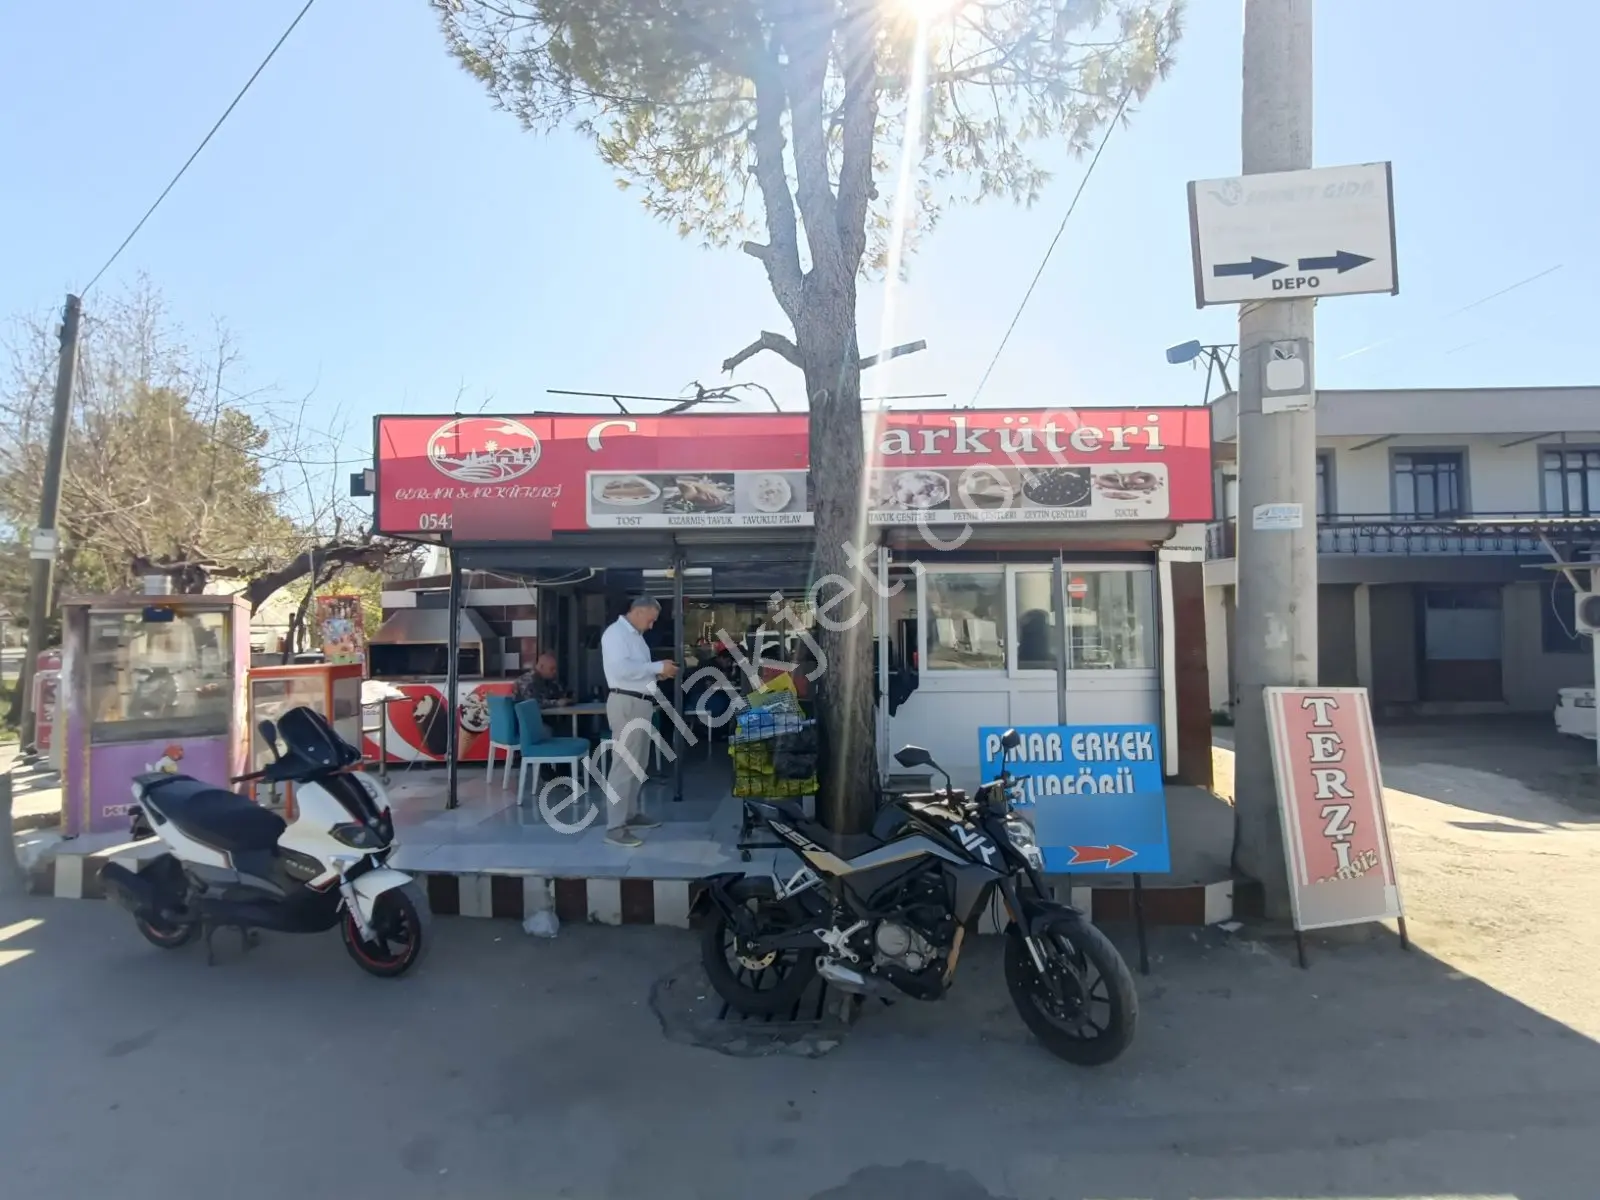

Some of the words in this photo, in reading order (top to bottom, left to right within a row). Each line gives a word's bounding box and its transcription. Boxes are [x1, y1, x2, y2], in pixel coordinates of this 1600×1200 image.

[1272, 275, 1320, 291] DEPO
[879, 412, 1166, 457] arküteri
[742, 514, 778, 525] TAVUKLU
[1114, 508, 1139, 518] SUCUK
[615, 516, 642, 525] TOST
[1071, 730, 1154, 762] ERKEK
